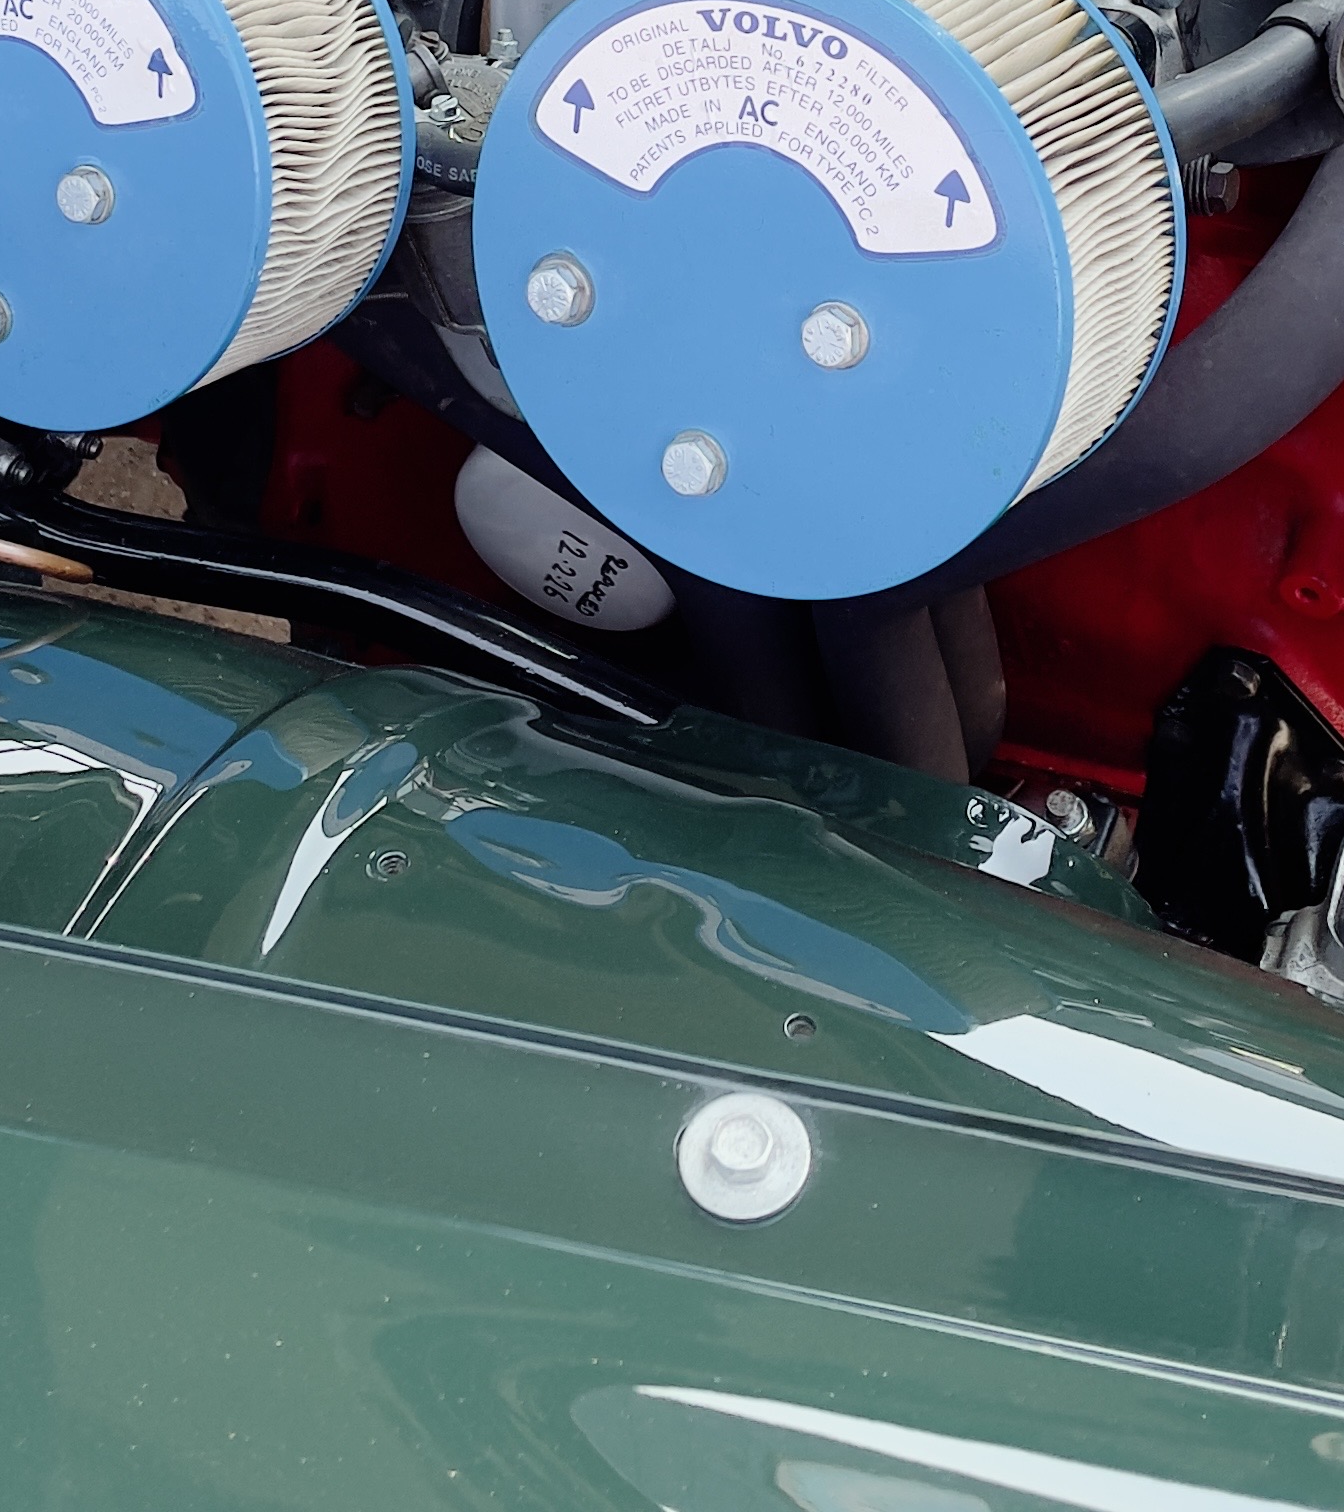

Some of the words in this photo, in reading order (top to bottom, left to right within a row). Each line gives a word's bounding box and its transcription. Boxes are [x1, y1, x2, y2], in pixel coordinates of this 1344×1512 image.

[35, 27, 62, 51] FOR
[64, 49, 94, 85] TYPE
[91, 87, 103, 103] PC
[49, 15, 107, 79] ENGLAND
[100, 18, 133, 59] MILES
[104, 47, 125, 72] KM
[612, 19, 689, 54] ORIGINAL
[697, 8, 848, 60] VOLVO
[856, 59, 909, 112] FILTER
[607, 86, 628, 105] TO
[629, 73, 651, 93] BE
[657, 56, 752, 81] DISCARDED
[762, 61, 817, 91] AFTER
[873, 129, 914, 179] MILES
[615, 86, 673, 128] FILTRET
[677, 75, 756, 97] UTBYTES
[766, 80, 824, 116] EFTER
[876, 163, 900, 192] KM
[644, 103, 691, 134] MADE
[704, 98, 722, 113] IN
[738, 95, 778, 127] AC
[804, 121, 877, 198] ENGLAND
[417, 156, 442, 178] OSE
[630, 129, 686, 181] PATENTS
[695, 121, 763, 137] APPLIED
[778, 131, 814, 160] FOR
[816, 154, 855, 195] TYPE
[851, 195, 873, 221] PC
[865, 225, 879, 235] 2
